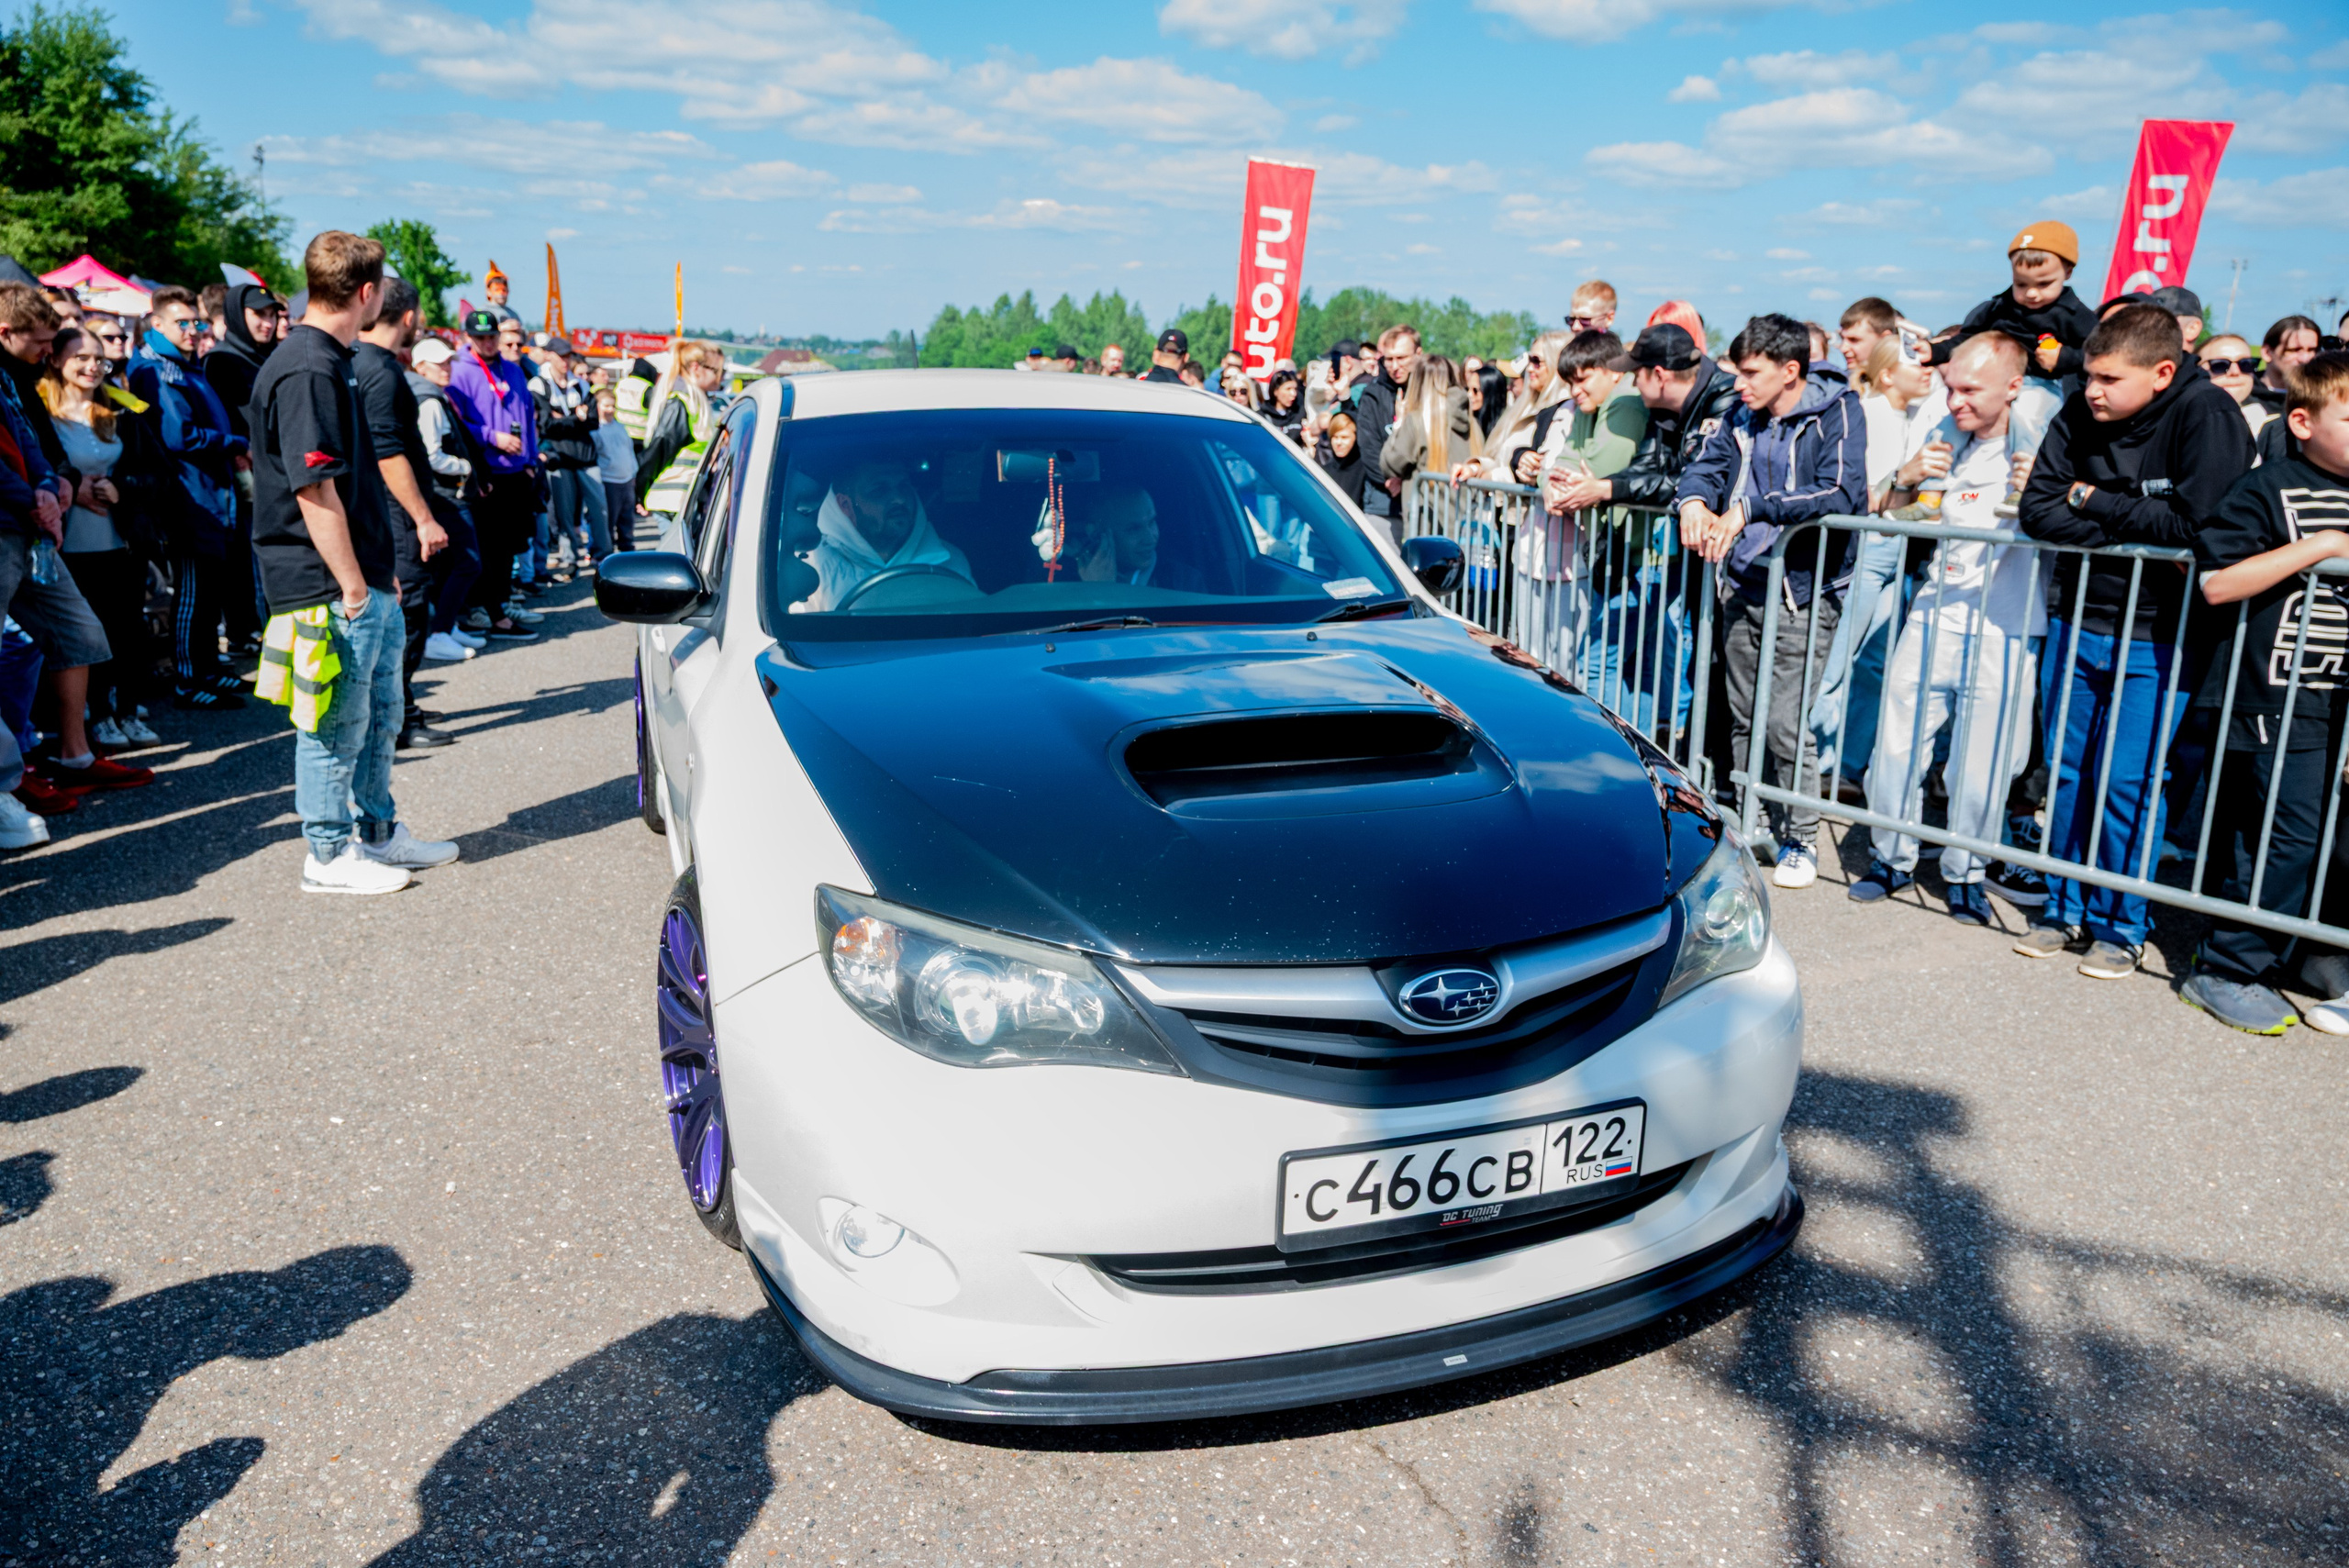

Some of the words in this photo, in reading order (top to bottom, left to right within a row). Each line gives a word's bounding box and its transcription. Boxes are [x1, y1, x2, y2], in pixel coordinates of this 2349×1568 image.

[2121, 174, 2188, 295] o.ru
[1244, 206, 1293, 378] uto.ru
[1553, 1117, 1626, 1167] 122
[1566, 1163, 1603, 1184] RUS
